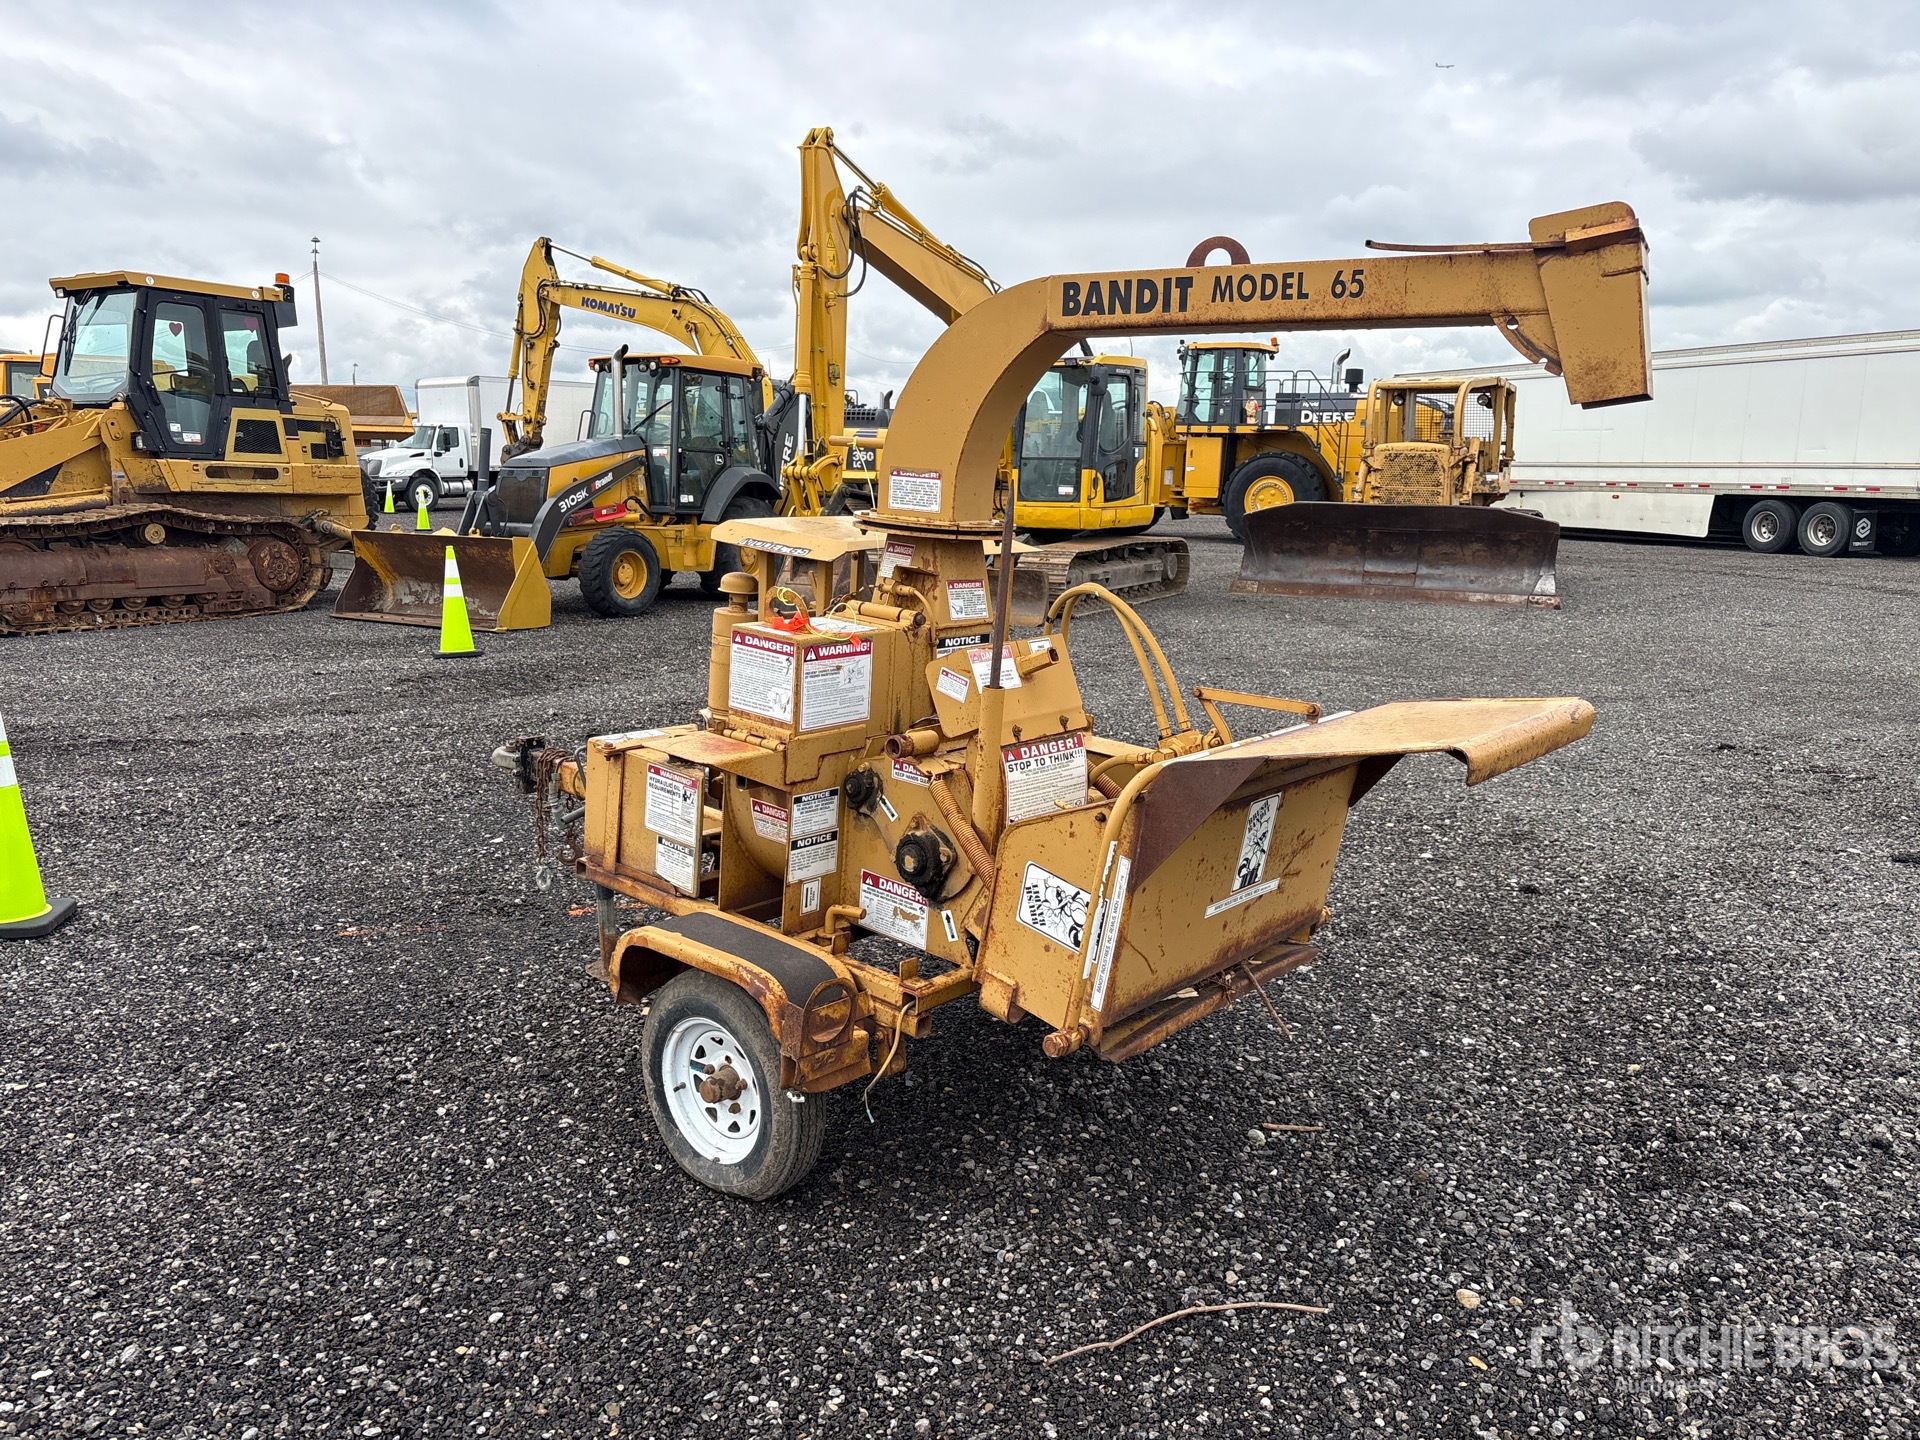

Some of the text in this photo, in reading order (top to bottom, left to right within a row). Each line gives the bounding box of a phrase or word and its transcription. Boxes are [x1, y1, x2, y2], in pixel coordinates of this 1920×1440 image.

[1062, 269, 1365, 317] BANDIT MODEL 65
[581, 296, 637, 319] KOMATSU
[1301, 410, 1356, 423] DEERE
[558, 486, 590, 513] 310SK
[745, 635, 794, 655] DANGER!
[818, 642, 870, 657] WARNING!
[945, 635, 981, 647] NOTICE
[981, 648, 1009, 661] DANR!
[1020, 737, 1079, 758] DANGER!
[1008, 760, 1031, 773] STOP
[1035, 758, 1046, 767] TO
[1048, 748, 1084, 764] THINK!!!
[649, 776, 673, 789] HYDRAULIC
[660, 769, 693, 786] WARNING!
[649, 782, 681, 799] REQUIREMENTS
[802, 791, 831, 802] NOTICE
[762, 805, 787, 820] DANGER!
[797, 833, 832, 848] NOTICE
[1026, 886, 1039, 925] BRUSH
[1031, 883, 1047, 926] BANDIT
